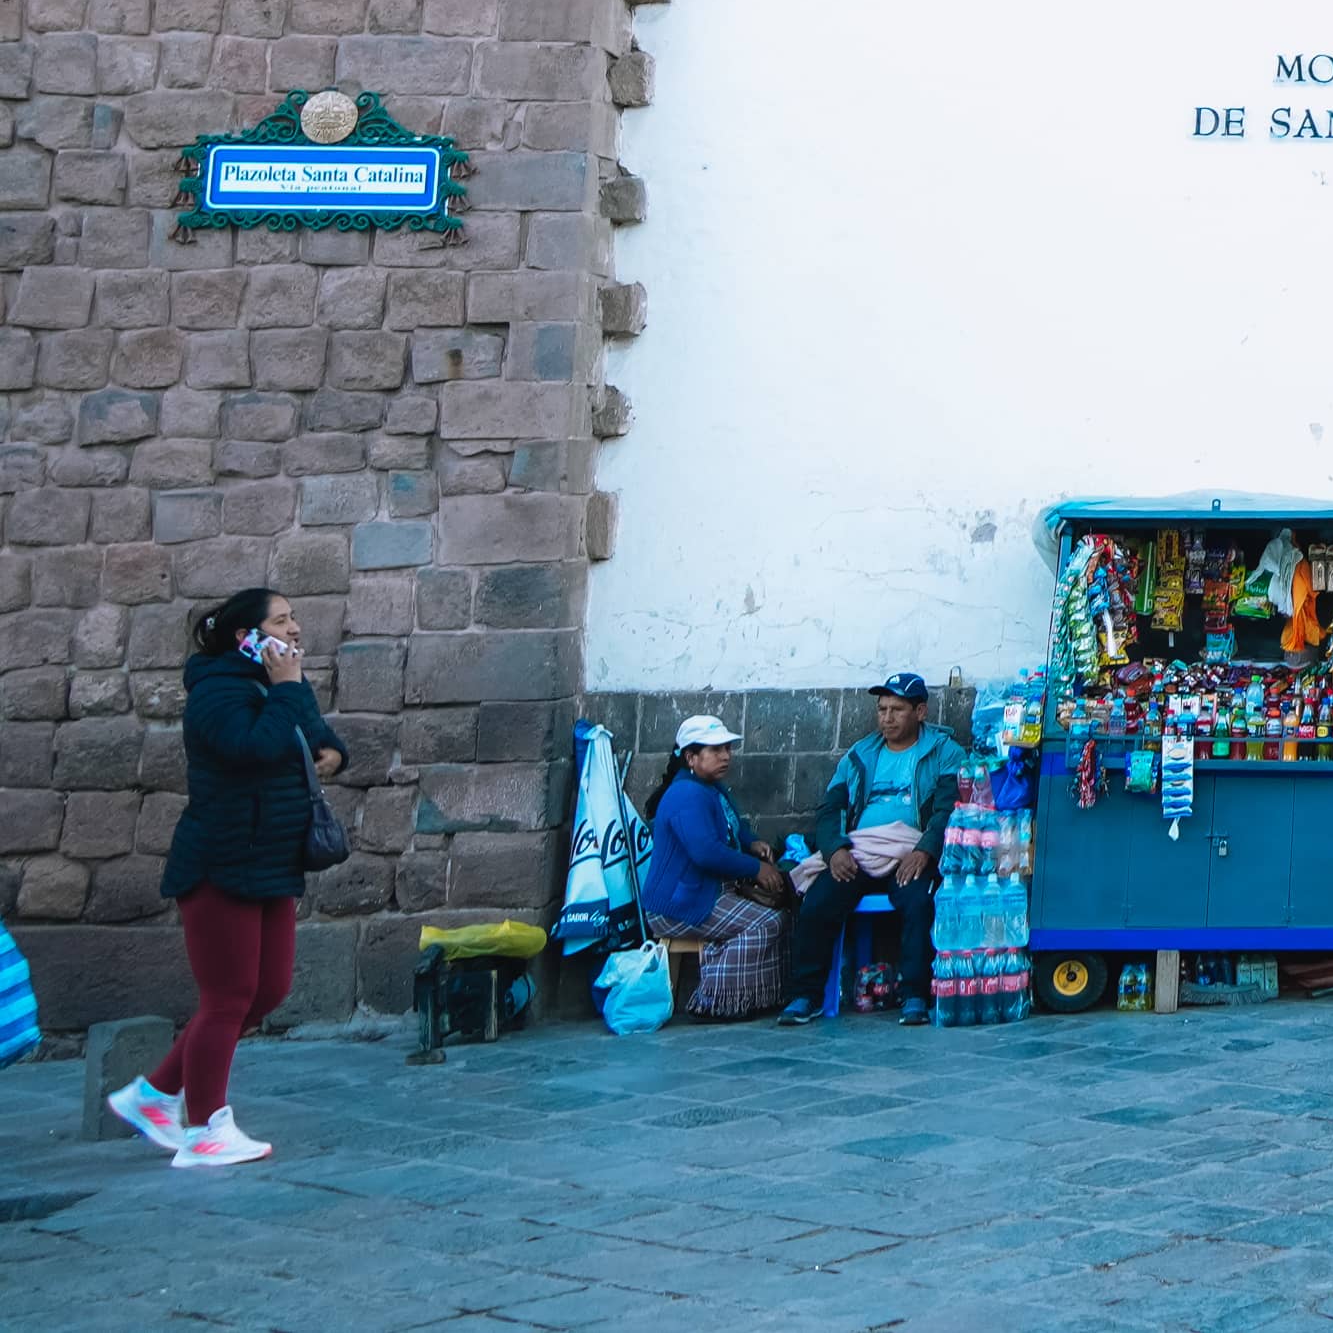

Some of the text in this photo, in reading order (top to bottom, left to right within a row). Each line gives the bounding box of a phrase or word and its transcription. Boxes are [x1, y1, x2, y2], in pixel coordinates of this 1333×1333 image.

[1193, 107, 1246, 137] DE
[223, 165, 424, 183] Plazoleta Santa Catalina
